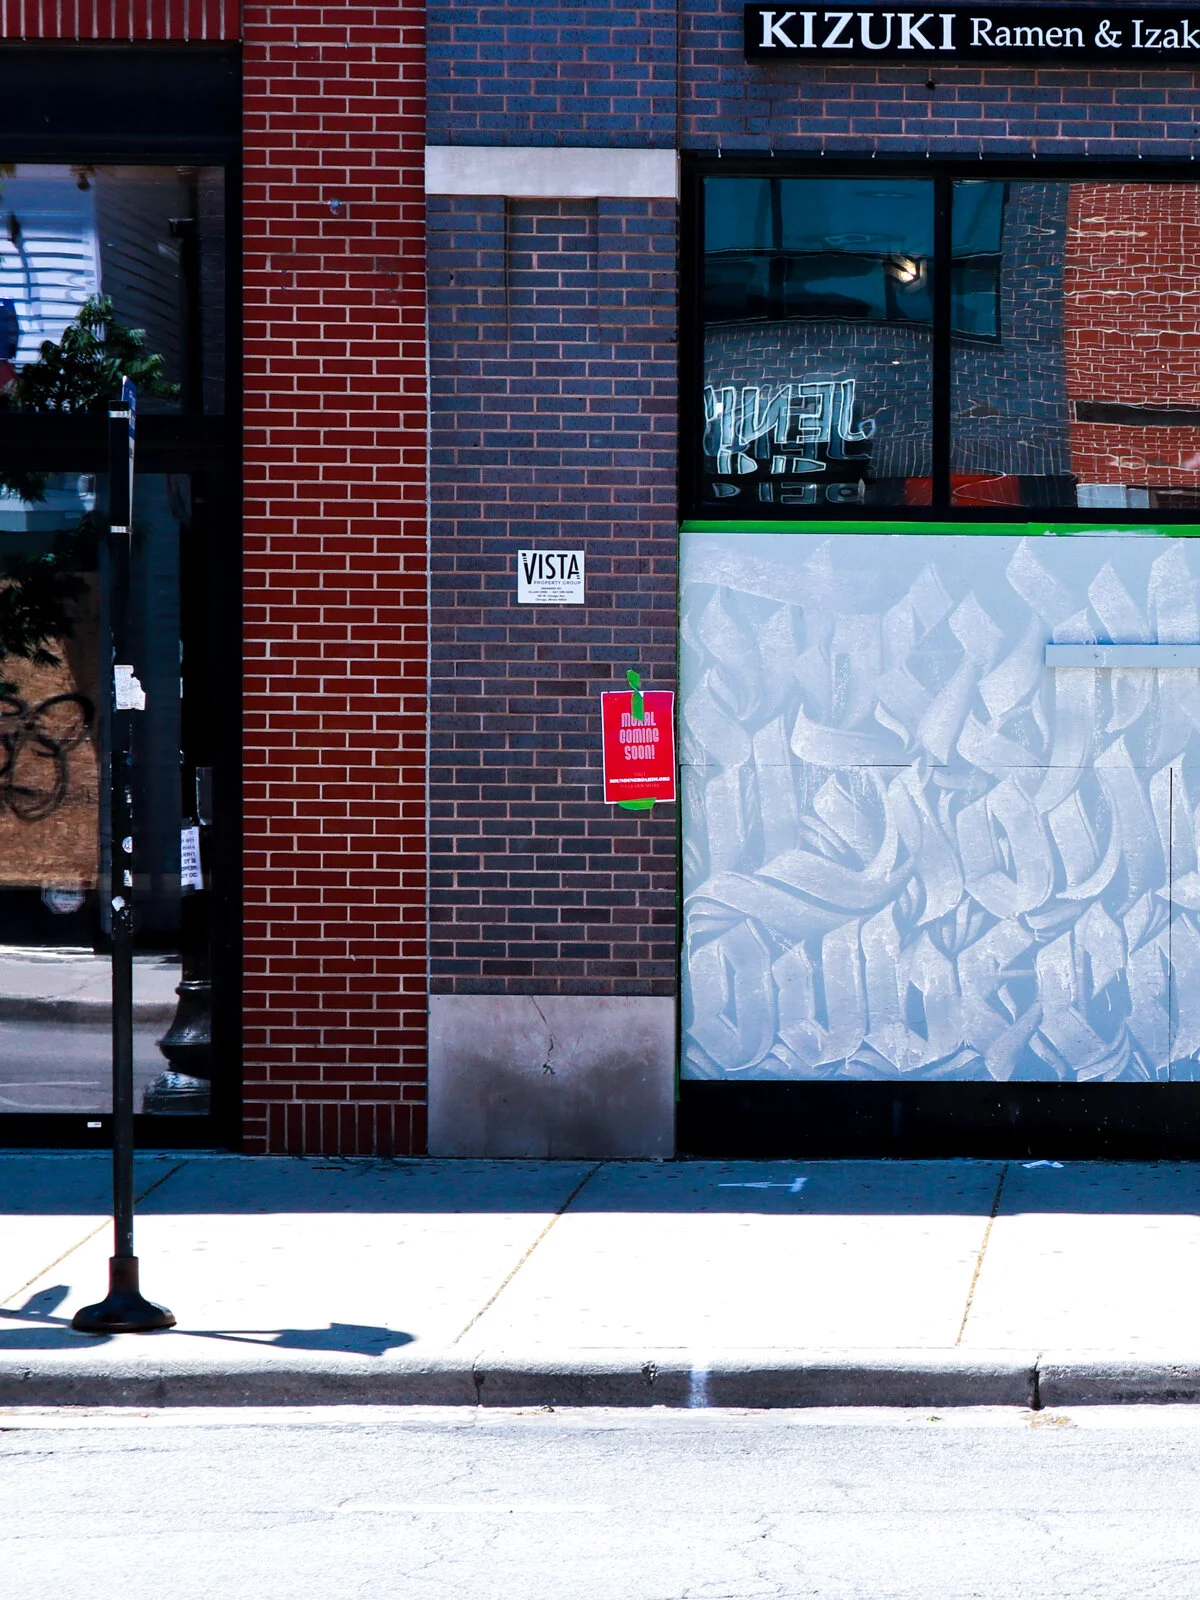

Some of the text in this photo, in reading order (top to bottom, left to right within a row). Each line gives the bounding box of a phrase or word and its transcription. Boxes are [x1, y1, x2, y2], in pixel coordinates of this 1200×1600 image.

[759, 10, 956, 50] KIZUKI
[969, 17, 1085, 48] Ramen
[1094, 19, 1122, 48] &
[521, 552, 581, 585] VISTA
[619, 727, 660, 744] COMING
[624, 744, 655, 760] SOON!
